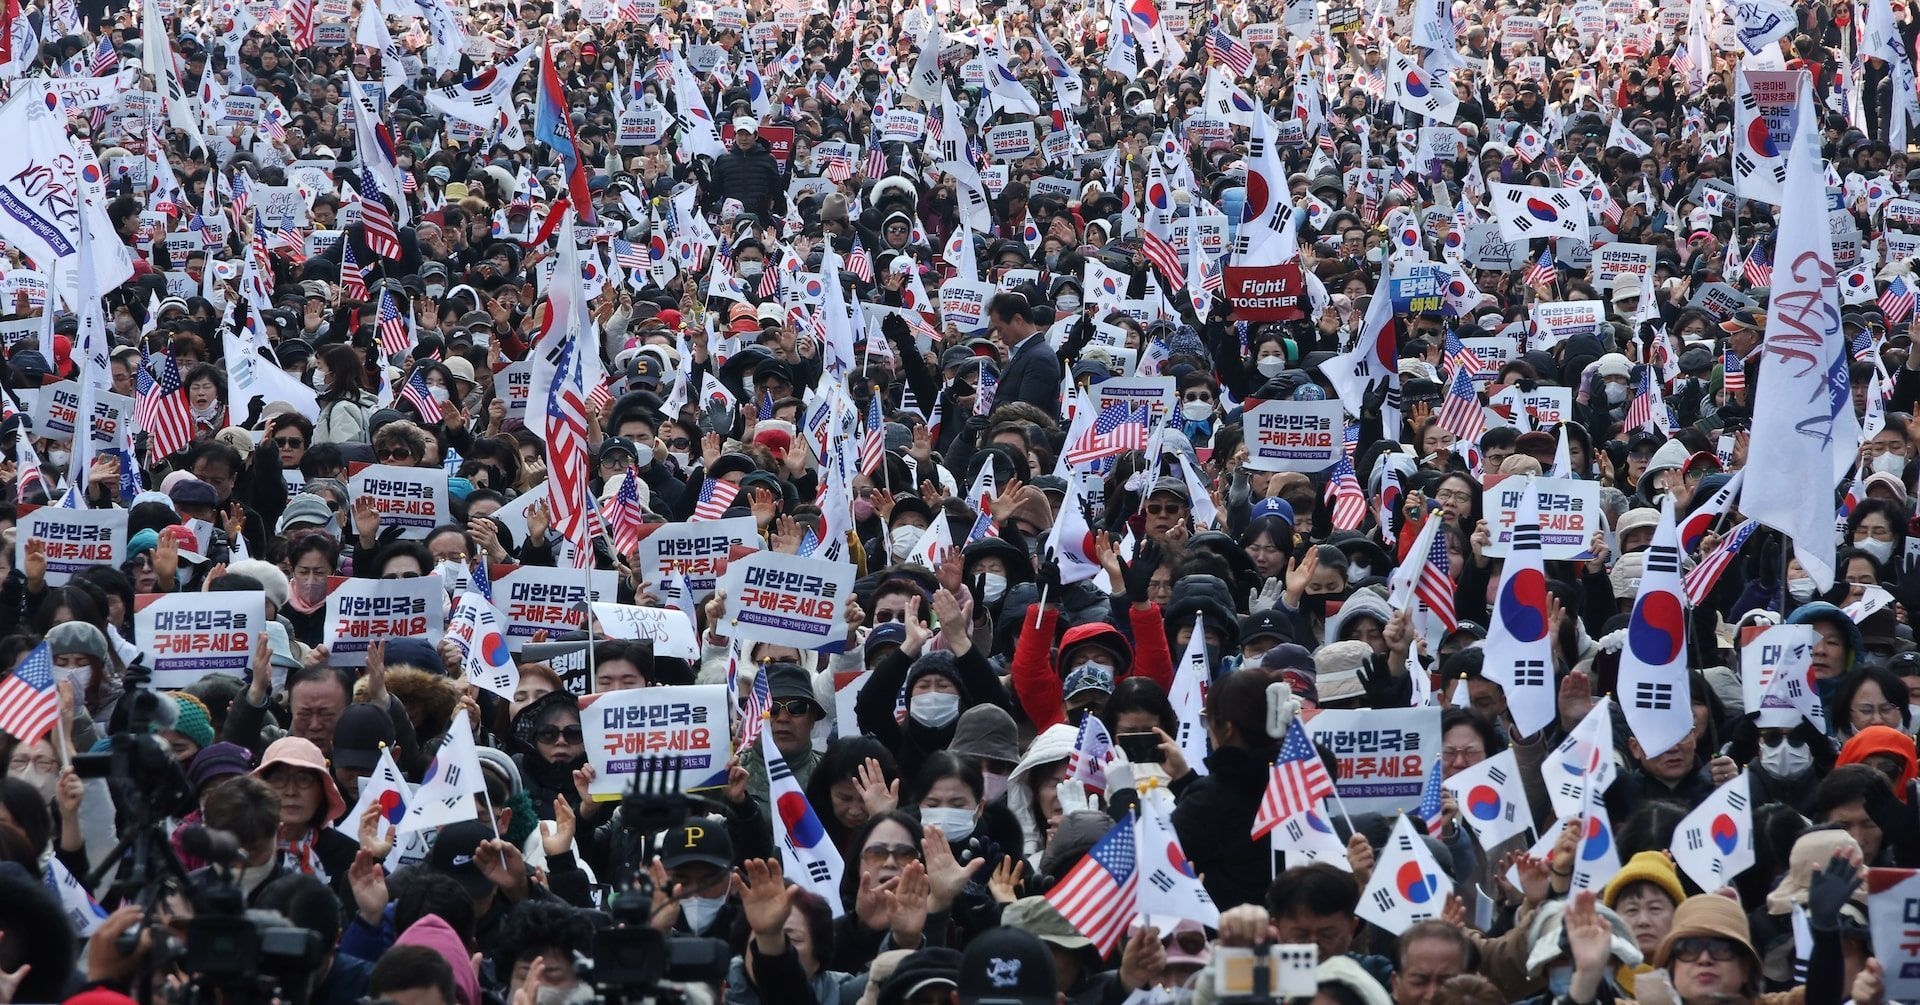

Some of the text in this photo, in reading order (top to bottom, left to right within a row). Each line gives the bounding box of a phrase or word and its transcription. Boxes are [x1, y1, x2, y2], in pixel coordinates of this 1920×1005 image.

[1753, 81, 1787, 92] 국정마비
[1752, 91, 1796, 103] 가재앙초래
[1760, 106, 1791, 117] 도하는
[620, 126, 657, 135] 구해주세요
[621, 118, 656, 127] 대한민국을
[993, 129, 1028, 141] 대한민국을
[993, 138, 1030, 149] 구해주세요
[1770, 132, 1792, 143] 낸다
[772, 139, 789, 150] 수호
[818, 146, 853, 157] 대한민을
[270, 192, 293, 205] SAVE
[1891, 204, 1920, 215] 대한민국
[1602, 251, 1647, 264] 대한민국을
[1601, 262, 1647, 274] 구해주세요
[1242, 279, 1287, 295] Fight!
[1231, 296, 1299, 309] TOGETHER
[1410, 296, 1445, 311] 해체!
[637, 361, 648, 375] S
[52, 390, 119, 420] 대한국을
[1259, 414, 1332, 431] 대한민국을
[1258, 430, 1332, 448] 구해주세요
[364, 478, 435, 499] 대한민국을
[376, 498, 436, 517] 해주세요
[1267, 498, 1279, 511] LA
[1501, 490, 1584, 512] 대민국을
[1499, 511, 1584, 531] 구주세요
[33, 521, 112, 542] 대한민국을
[46, 542, 113, 561] 해주세요
[745, 566, 838, 599] 대한민국을
[511, 582, 600, 604] 대한민국을
[339, 596, 427, 617] 대한민국을
[741, 587, 835, 621] 구해주세요
[155, 611, 248, 631] 대한민국을
[508, 603, 583, 626] 구해주세
[335, 617, 428, 639] 구해주세요
[153, 632, 249, 654] 구해주세요
[604, 702, 709, 730] 대한민국을
[604, 728, 711, 756] 구해주세요
[1313, 729, 1421, 754] 대한민국을
[1336, 755, 1423, 779] 해주세요
[684, 826, 705, 847] P
